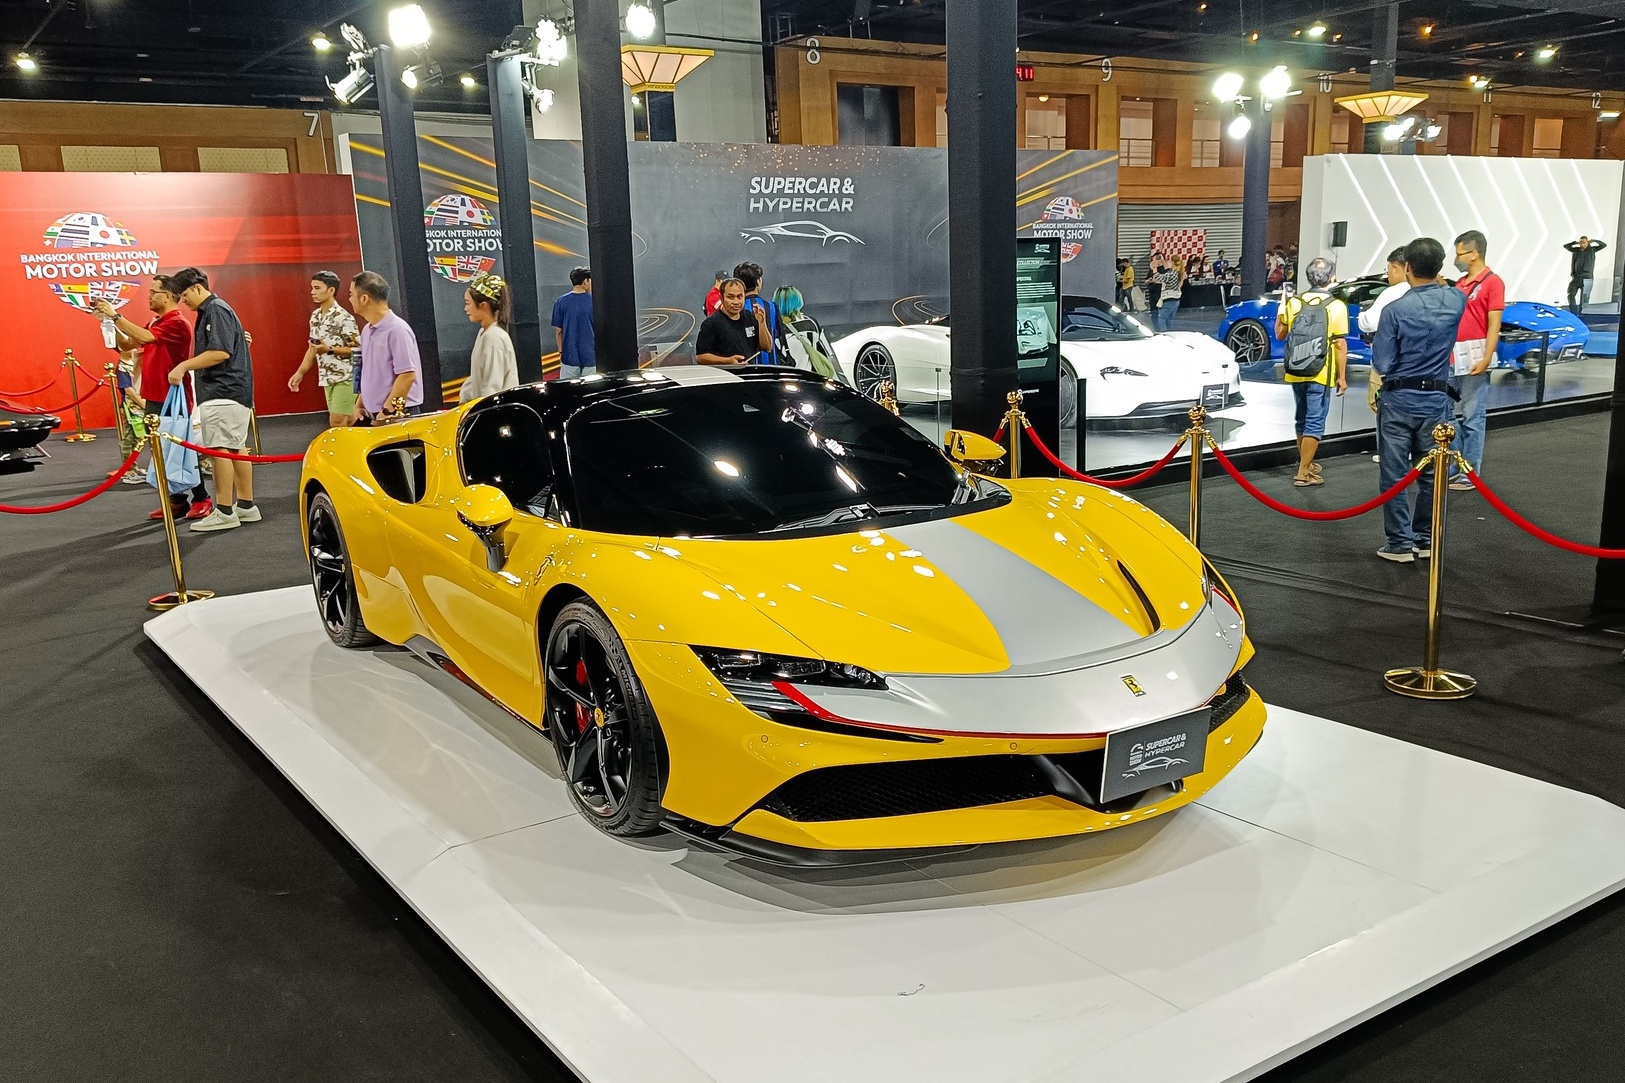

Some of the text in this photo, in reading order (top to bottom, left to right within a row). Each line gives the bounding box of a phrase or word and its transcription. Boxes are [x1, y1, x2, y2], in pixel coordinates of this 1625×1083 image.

[806, 37, 820, 64] 8
[1101, 58, 1112, 82] 9
[1318, 73, 1332, 92] 10
[1591, 92, 1601, 109] 12
[303, 112, 318, 136] 7
[749, 177, 841, 194] SUPERCAR
[749, 197, 854, 213] HYPERCAR
[447, 229, 502, 238] INTERNATION
[1033, 229, 1093, 240] MOTOR SHOW
[426, 238, 464, 252] OTOR
[20, 250, 160, 263] BANGKOK INTERNATIONAL
[25, 260, 158, 280] MOTOR SHOW
[1292, 337, 1323, 362] NIKE
[620, 669, 638, 720] MICHELIN
[1145, 742, 1185, 757] HYPERCAR
[1146, 734, 1181, 751] SUPERCAR
